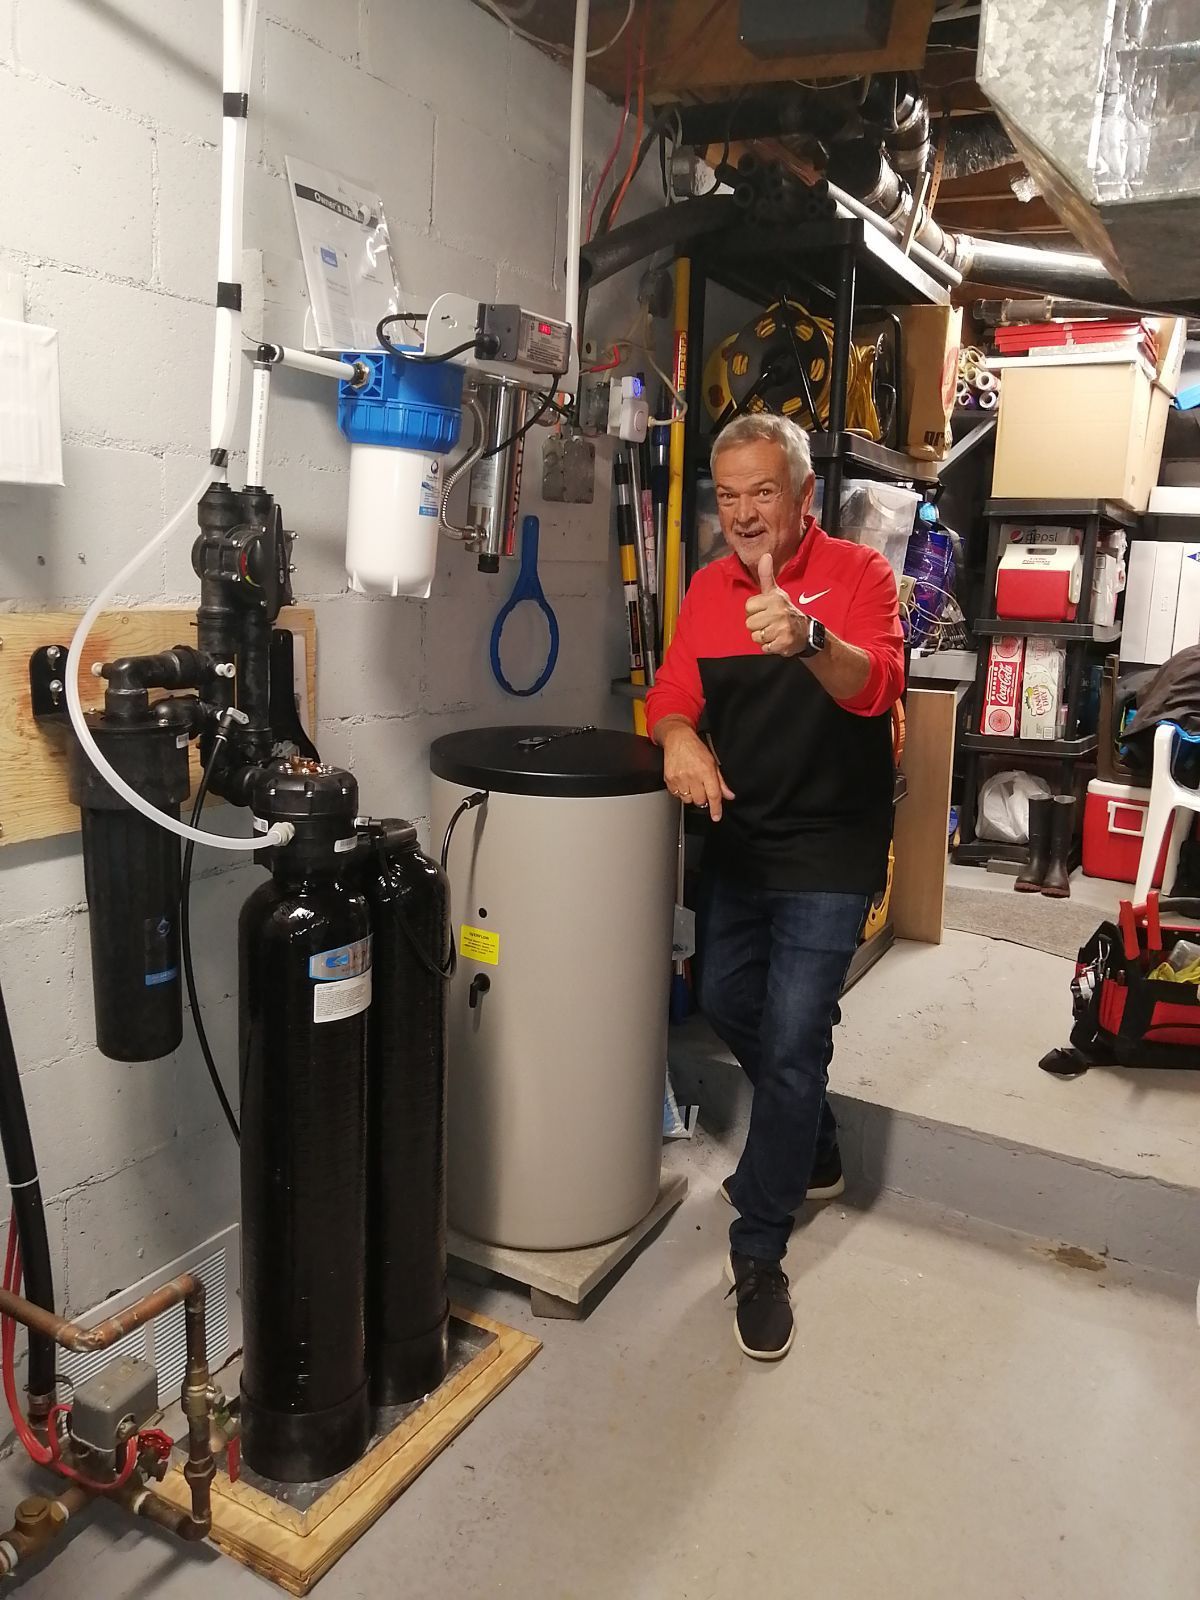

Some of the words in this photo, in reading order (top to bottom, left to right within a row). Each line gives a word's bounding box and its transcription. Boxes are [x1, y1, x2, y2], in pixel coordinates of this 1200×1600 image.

[315, 192, 342, 213] Owner's
[997, 663, 1013, 704] Coca-Cola
[1032, 684, 1046, 715] CANADA
[1041, 691, 1049, 707] DRY
